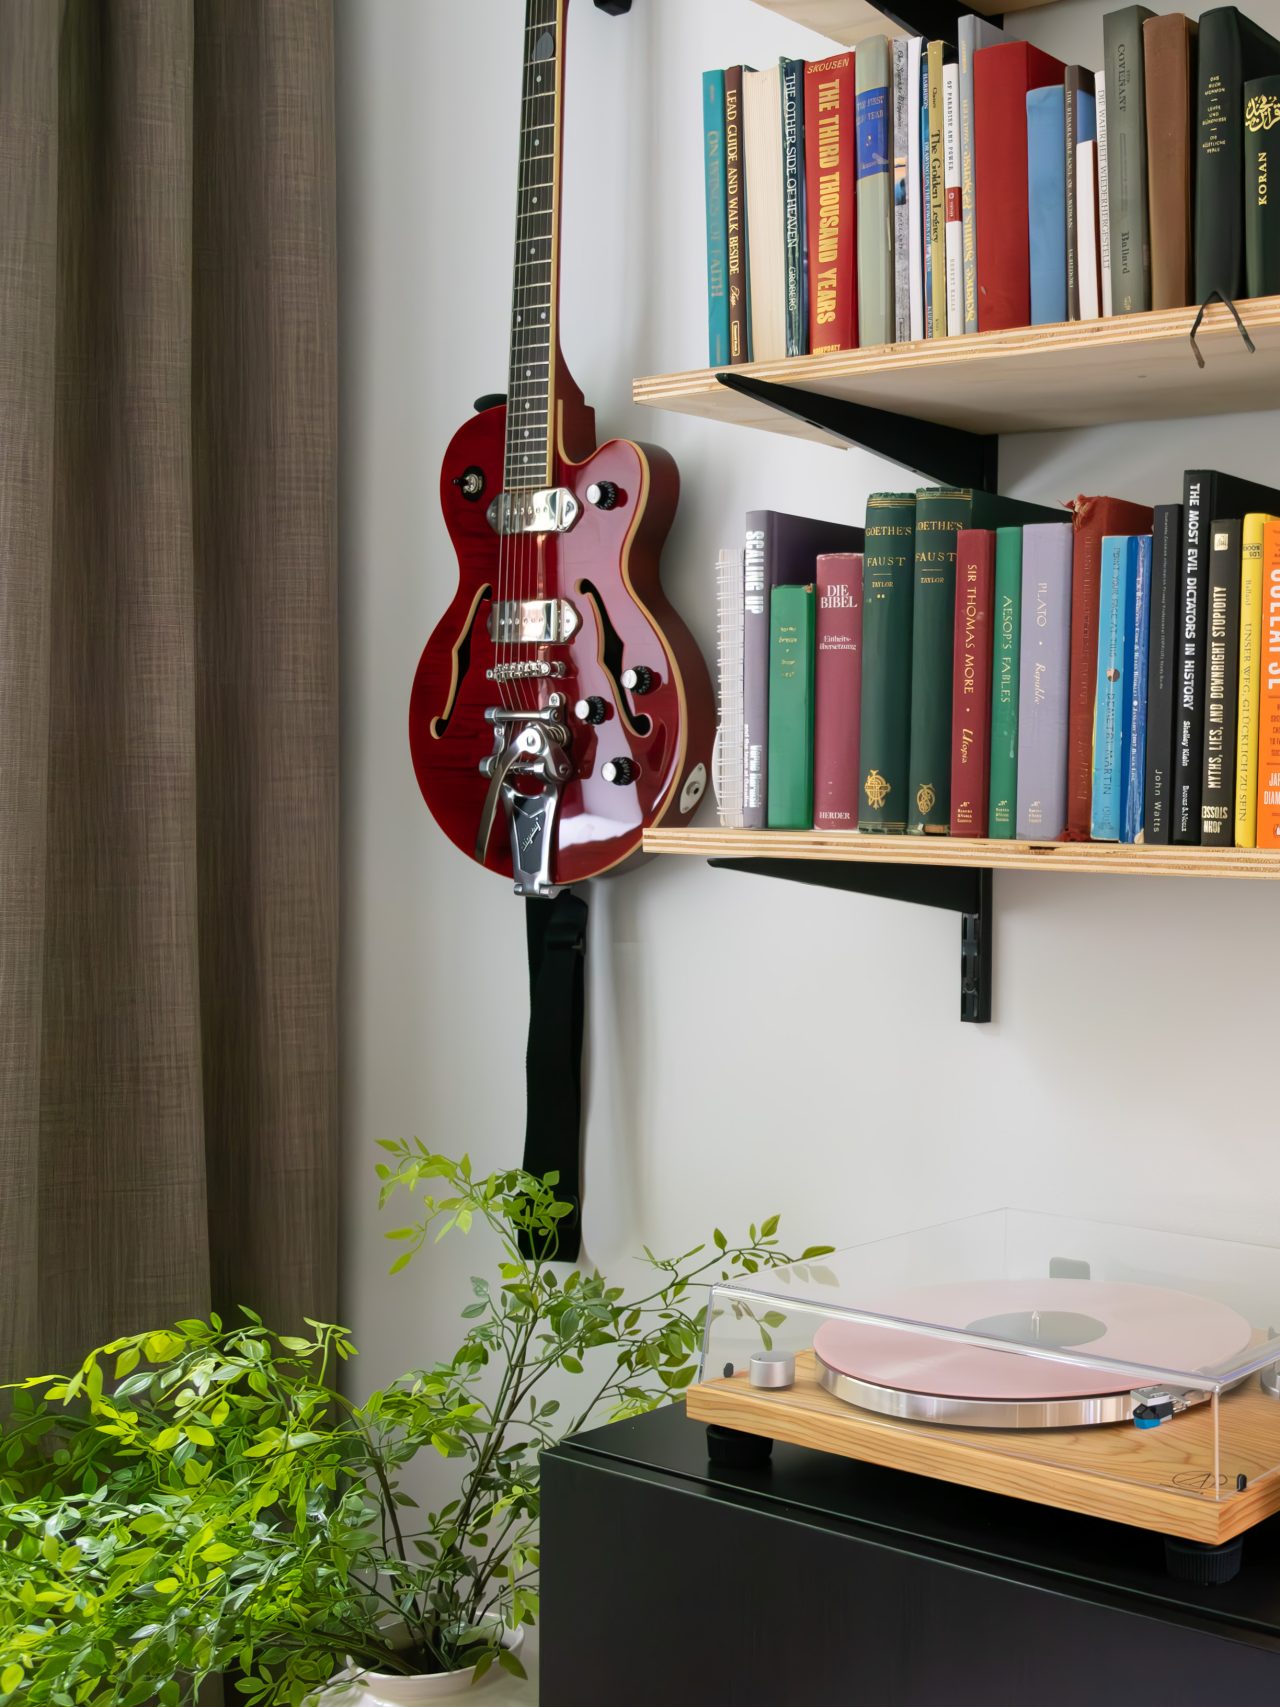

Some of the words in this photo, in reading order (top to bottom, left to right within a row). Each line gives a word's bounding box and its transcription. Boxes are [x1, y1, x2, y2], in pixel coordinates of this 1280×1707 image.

[807, 59, 849, 74] SKOUSEN
[818, 79, 839, 112] THE
[818, 115, 839, 169] THIRD
[931, 130, 941, 154] The
[729, 168, 738, 194] AND
[931, 158, 941, 199] Golden
[1258, 152, 1268, 206] KORAN
[729, 198, 739, 233] WALK
[817, 172, 840, 262] THOUSAND
[931, 204, 942, 243] Legacy
[729, 236, 740, 275] BESIDE
[816, 268, 838, 324] YEARS
[1189, 484, 1200, 506] THE
[1188, 510, 1199, 544] MOST
[745, 531, 763, 591] SCALING
[867, 558, 905, 567] FAUST
[966, 565, 977, 581] SIR
[1187, 549, 1198, 573] EVIL
[745, 596, 763, 614] UP
[820, 597, 857, 609] BIBEL
[827, 584, 849, 597] DIE
[1036, 583, 1047, 627] PLATO
[965, 588, 977, 648] THOMAS
[1002, 596, 1013, 649] AESOP'S
[1185, 578, 1197, 639] DICTATORS
[1212, 587, 1227, 638] STUPIDITY
[1184, 643, 1195, 656] IN
[964, 654, 975, 694] MORE
[1001, 657, 1011, 703] FABLES
[1034, 663, 1046, 704] Republic
[1182, 660, 1195, 710] HISTORY
[1211, 642, 1226, 699] DOWNRIGHT
[1210, 704, 1224, 723] AND
[961, 729, 973, 764] Utopia
[1209, 727, 1223, 751] LIES,
[1154, 769, 1163, 795] John
[1208, 754, 1222, 789] MYTHS,
[819, 812, 850, 820] HERDER
[1153, 801, 1162, 833] Watts
